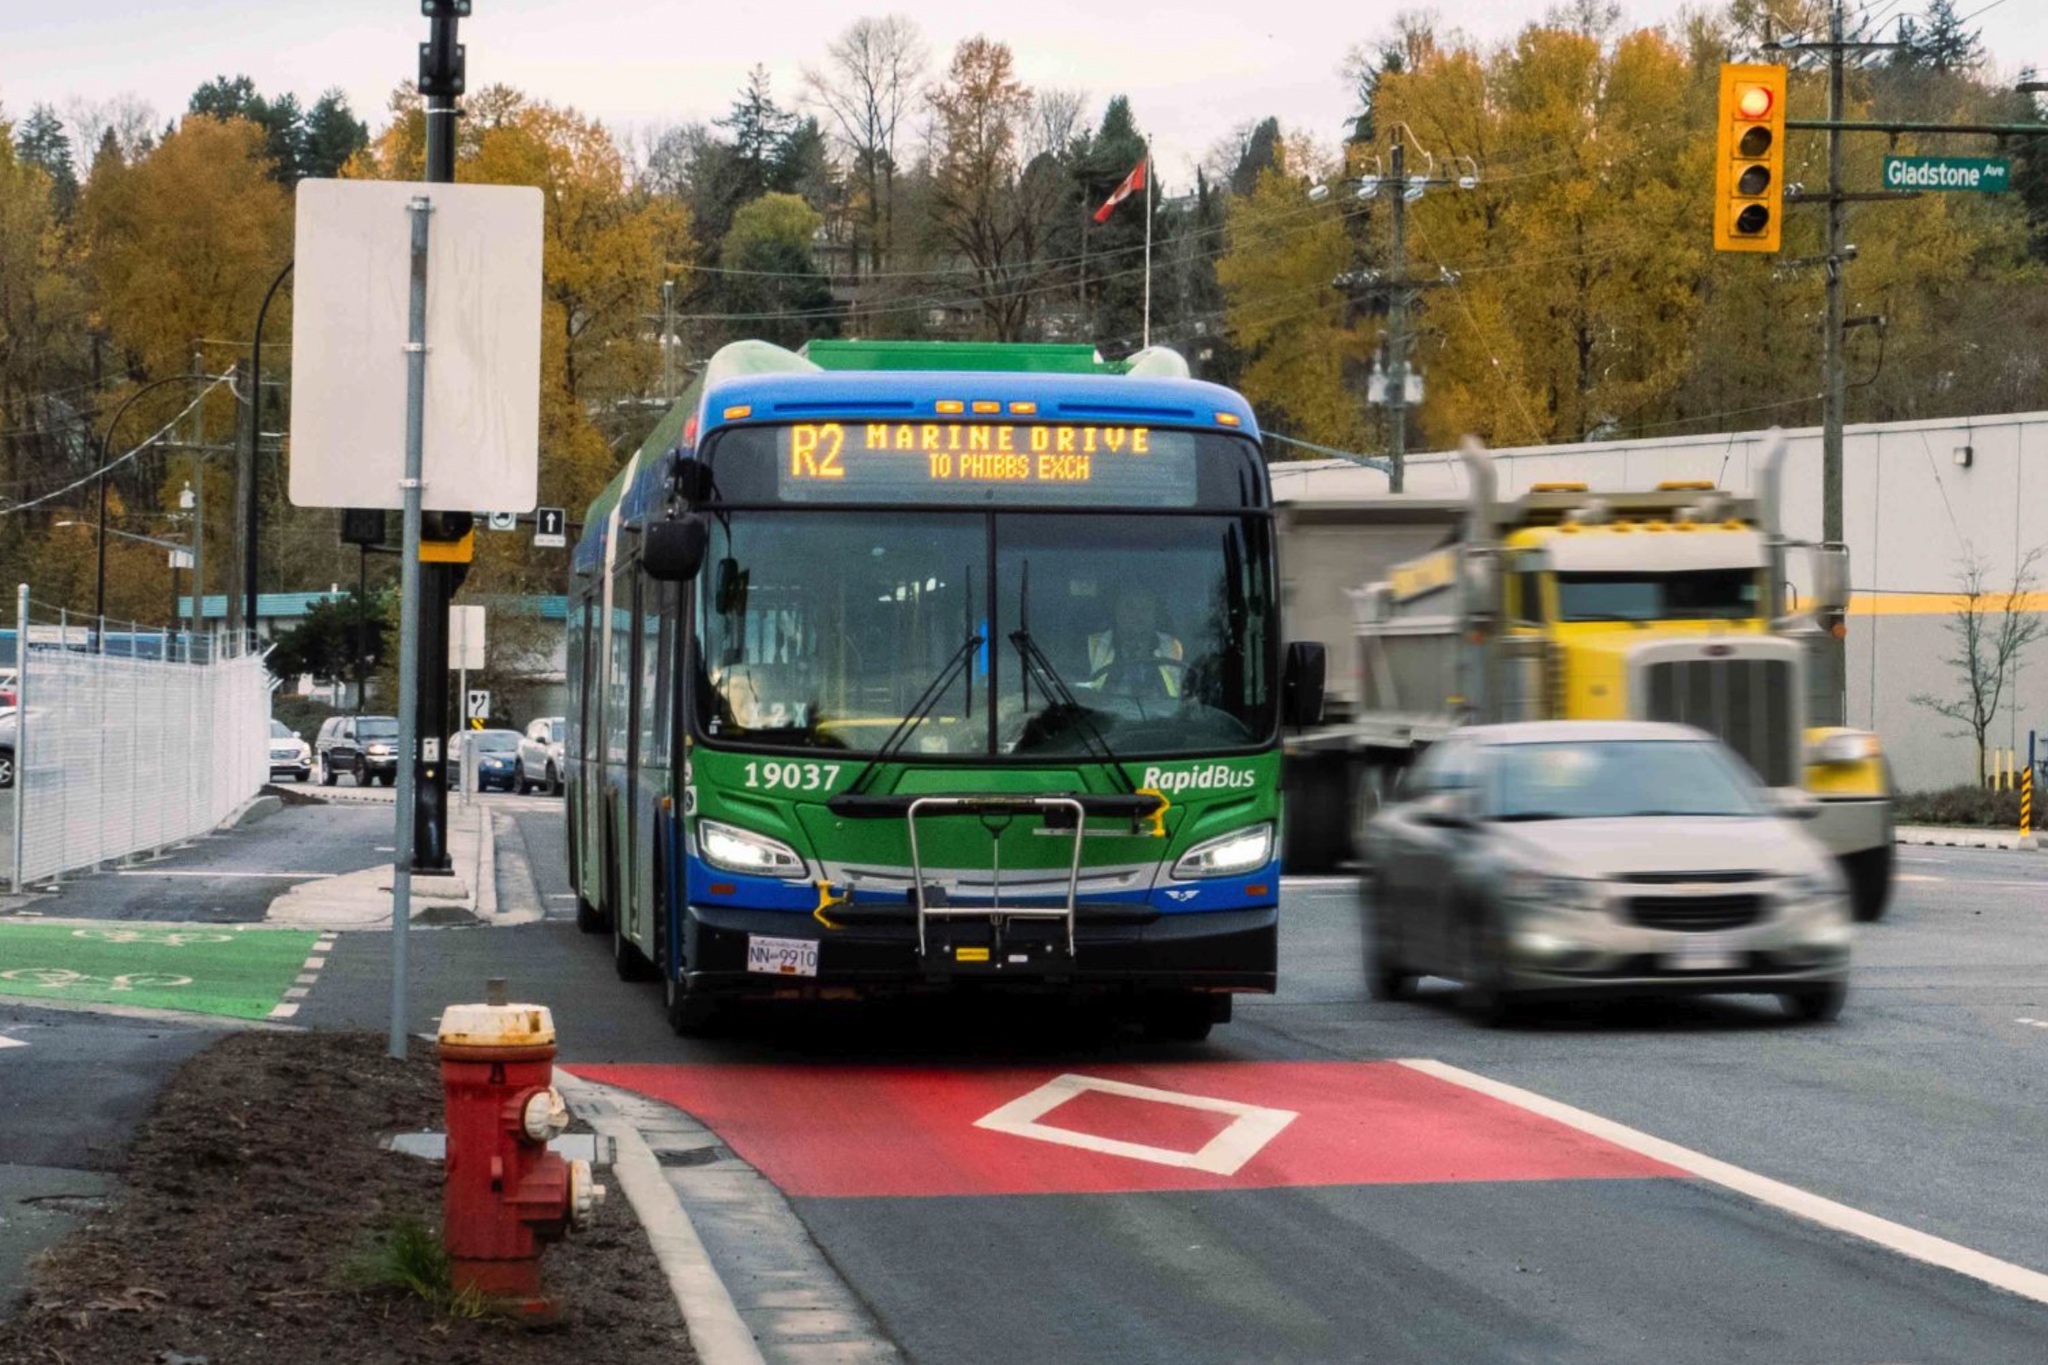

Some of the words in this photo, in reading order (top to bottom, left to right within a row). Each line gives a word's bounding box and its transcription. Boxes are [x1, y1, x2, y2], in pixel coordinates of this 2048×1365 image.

[1888, 160, 1980, 187] Gladstone
[1983, 163, 2005, 177] Ave
[791, 423, 845, 477] R2
[866, 423, 1014, 451] MARINE
[1030, 426, 1149, 453] DRIVE
[929, 453, 952, 479] TO
[959, 453, 1030, 480] PHIBBS
[1037, 455, 1090, 480] EXCH
[744, 762, 840, 791] 19037
[1143, 765, 1255, 795] RapidBus
